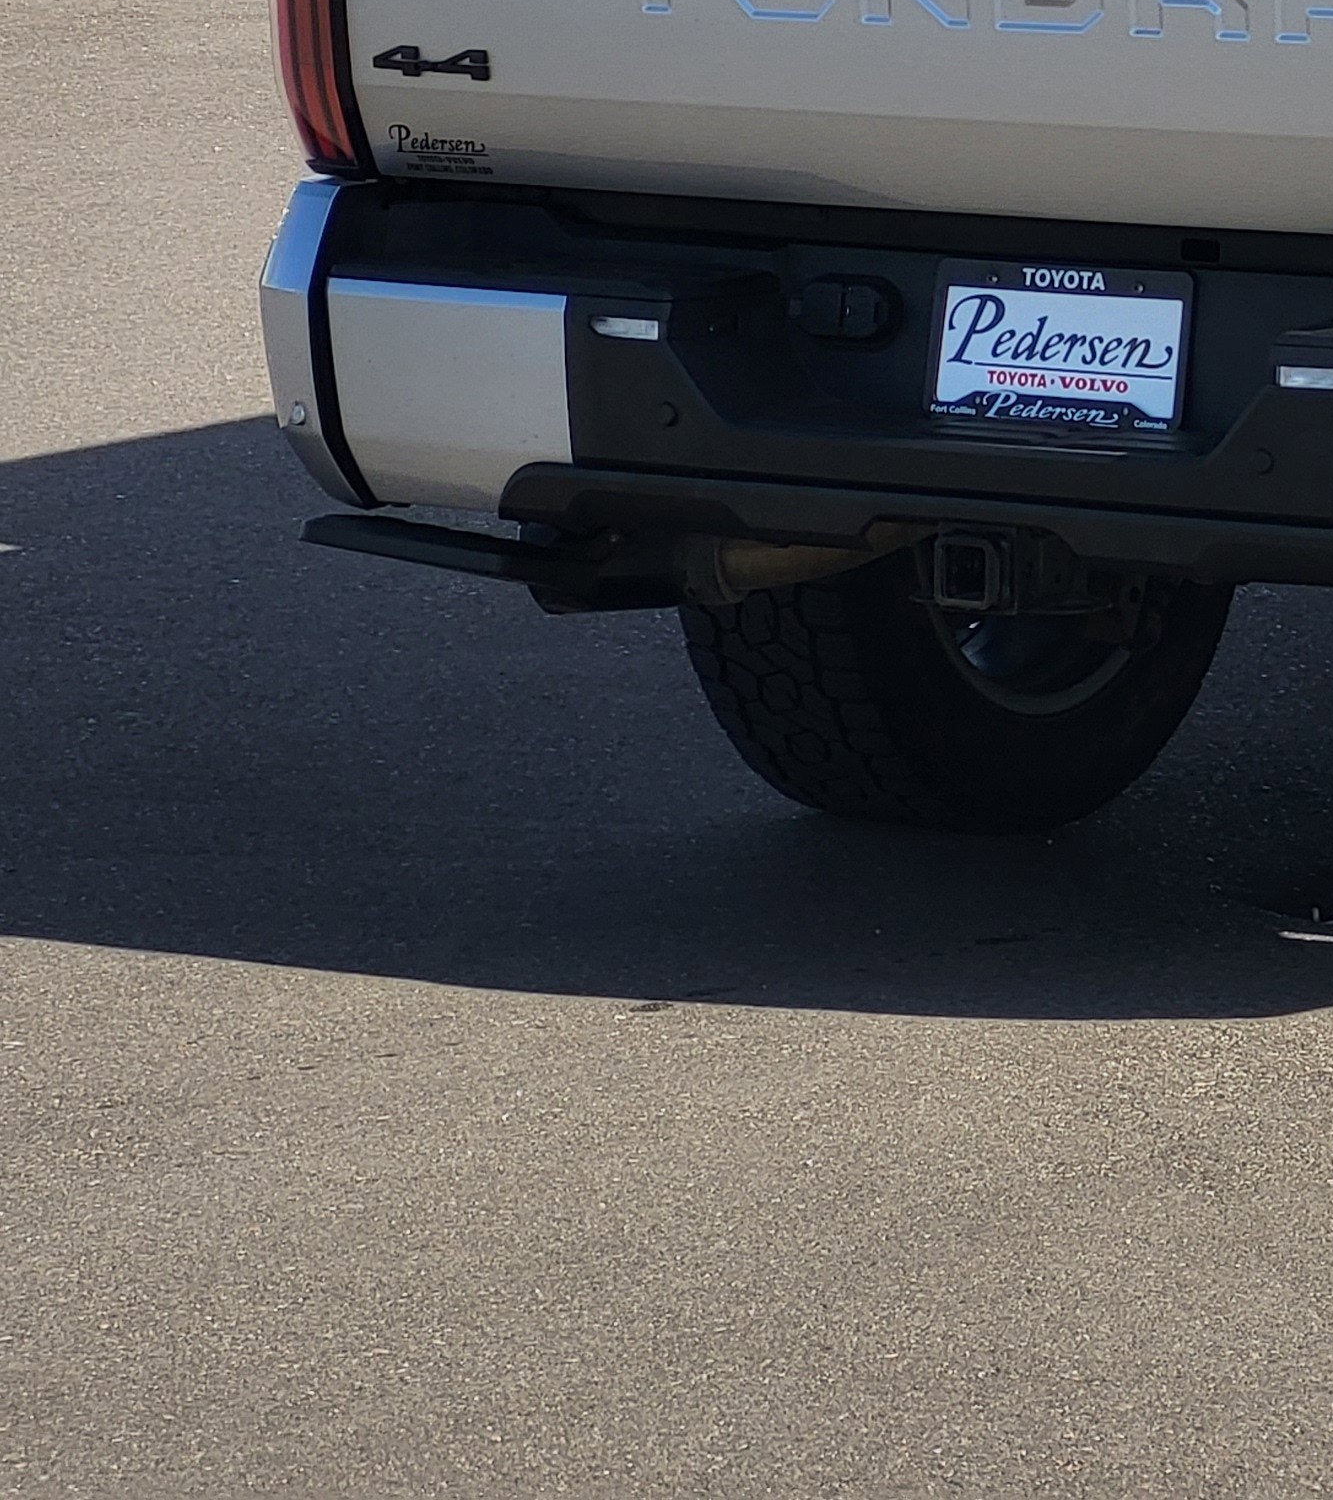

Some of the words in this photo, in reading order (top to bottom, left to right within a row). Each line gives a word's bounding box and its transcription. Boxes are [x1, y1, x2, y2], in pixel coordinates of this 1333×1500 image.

[388, 124, 487, 154] Pedersen
[1022, 266, 1106, 291] TOYOTA
[946, 293, 1174, 369] Pedersen
[986, 369, 1047, 389] TOYOTA
[1059, 375, 1129, 394] VOLVO
[930, 403, 948, 414] Fort
[949, 404, 976, 416] Collins
[982, 389, 1119, 423] Pedersen
[1133, 419, 1168, 430] Colorado
